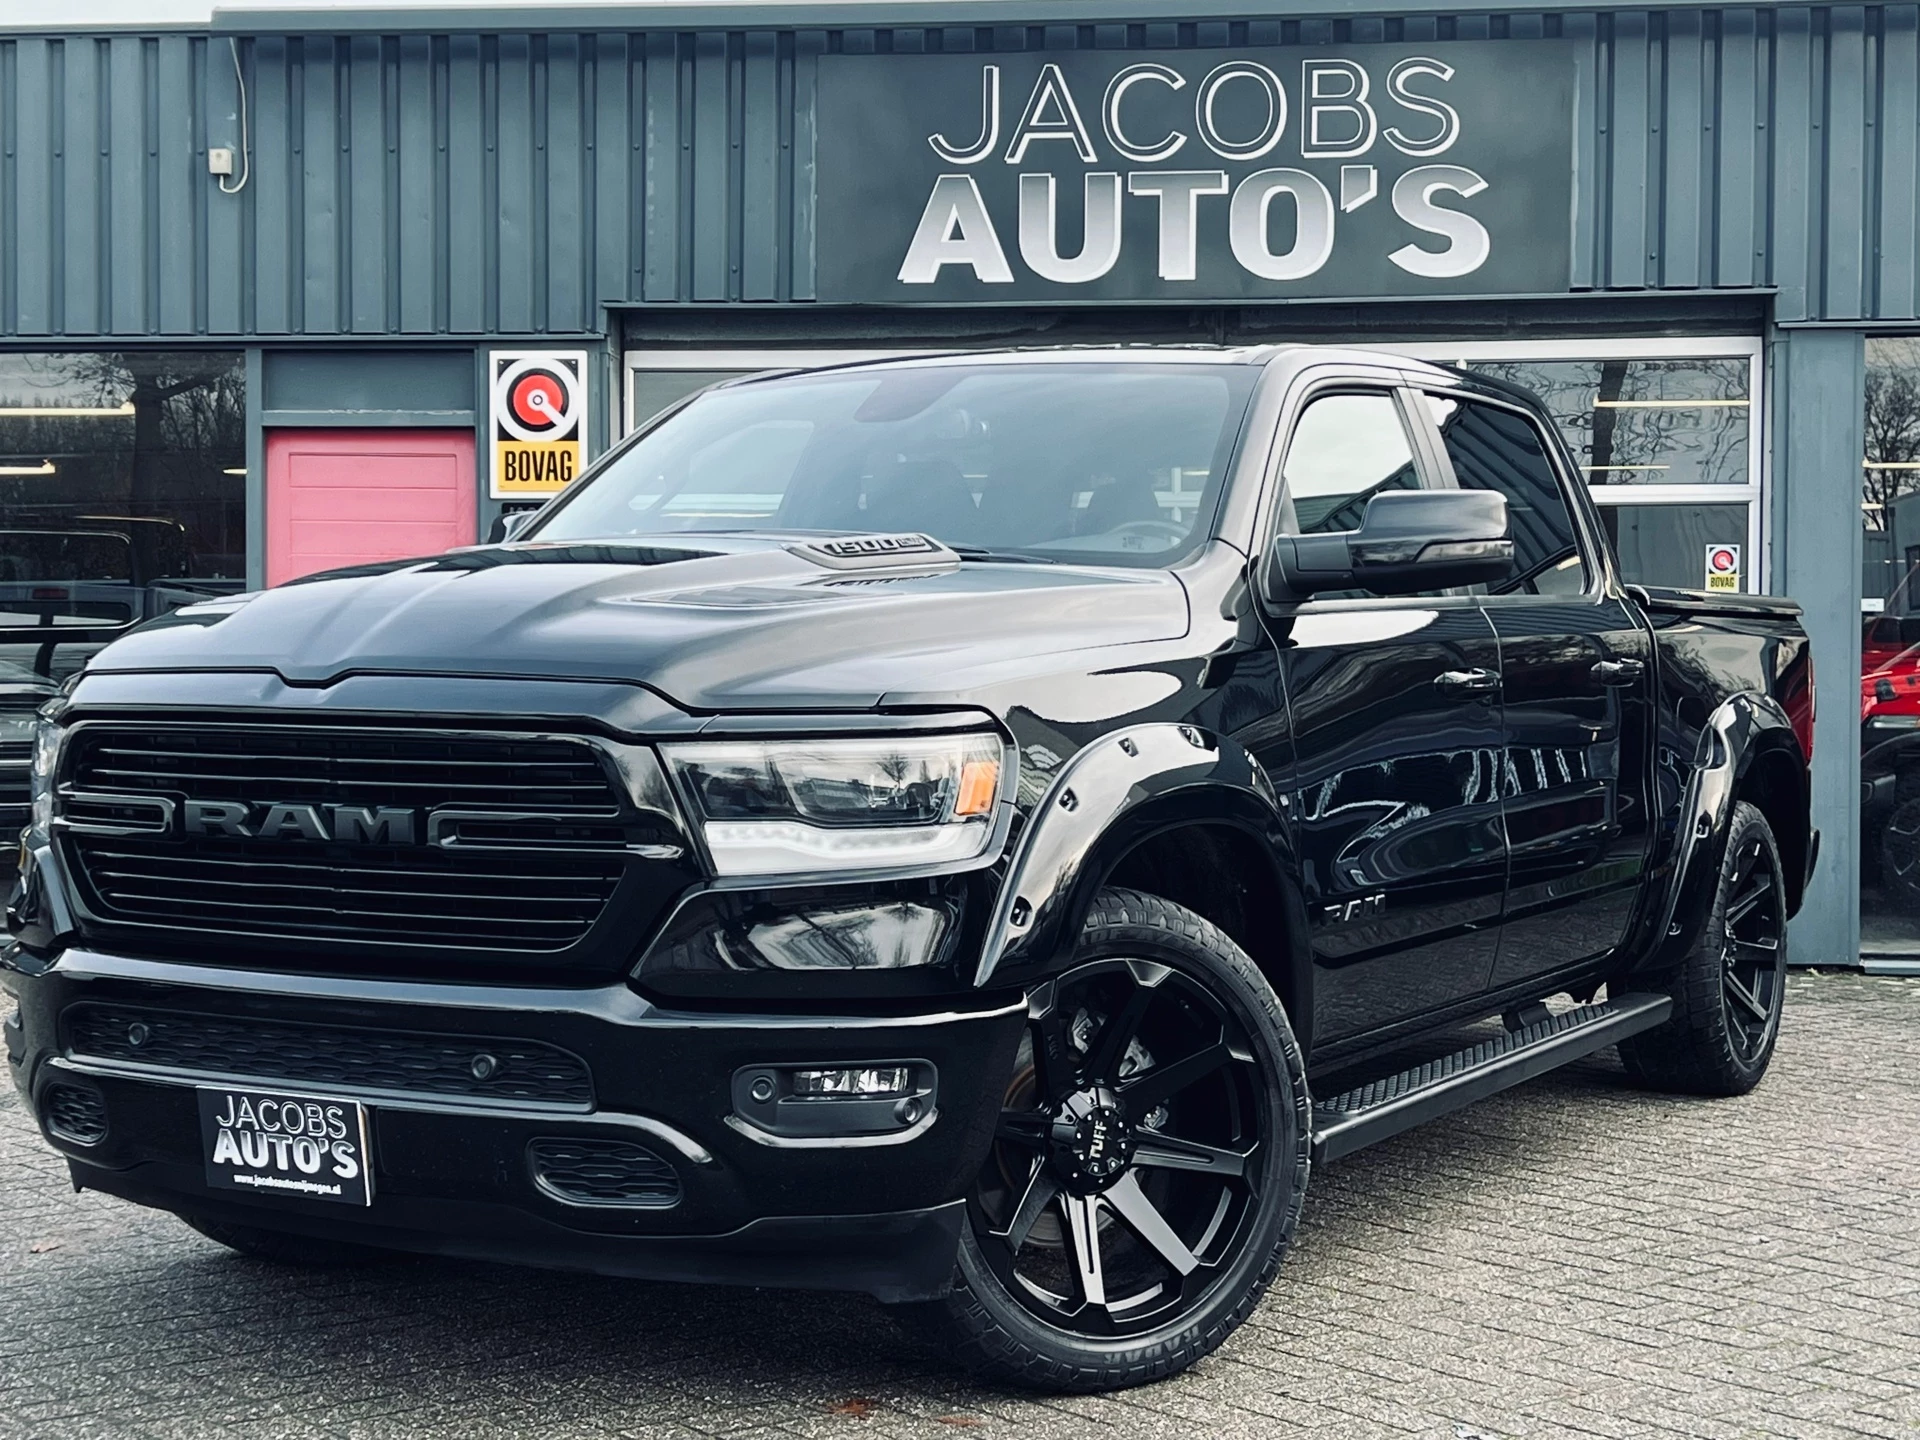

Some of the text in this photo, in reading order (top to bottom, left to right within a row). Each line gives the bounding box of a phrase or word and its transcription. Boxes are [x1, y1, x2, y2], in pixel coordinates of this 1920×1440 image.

[927, 56, 1461, 164] JACOBS
[897, 164, 1491, 284] AUTO'S
[504, 449, 573, 482] BOVAG
[823, 538, 900, 555] 1500
[1710, 576, 1735, 588] BOVAG
[184, 799, 416, 845] RAM
[215, 1095, 347, 1140] JACOBS
[1088, 1119, 1107, 1160] TUFF
[212, 1128, 359, 1180] AUTO'S
